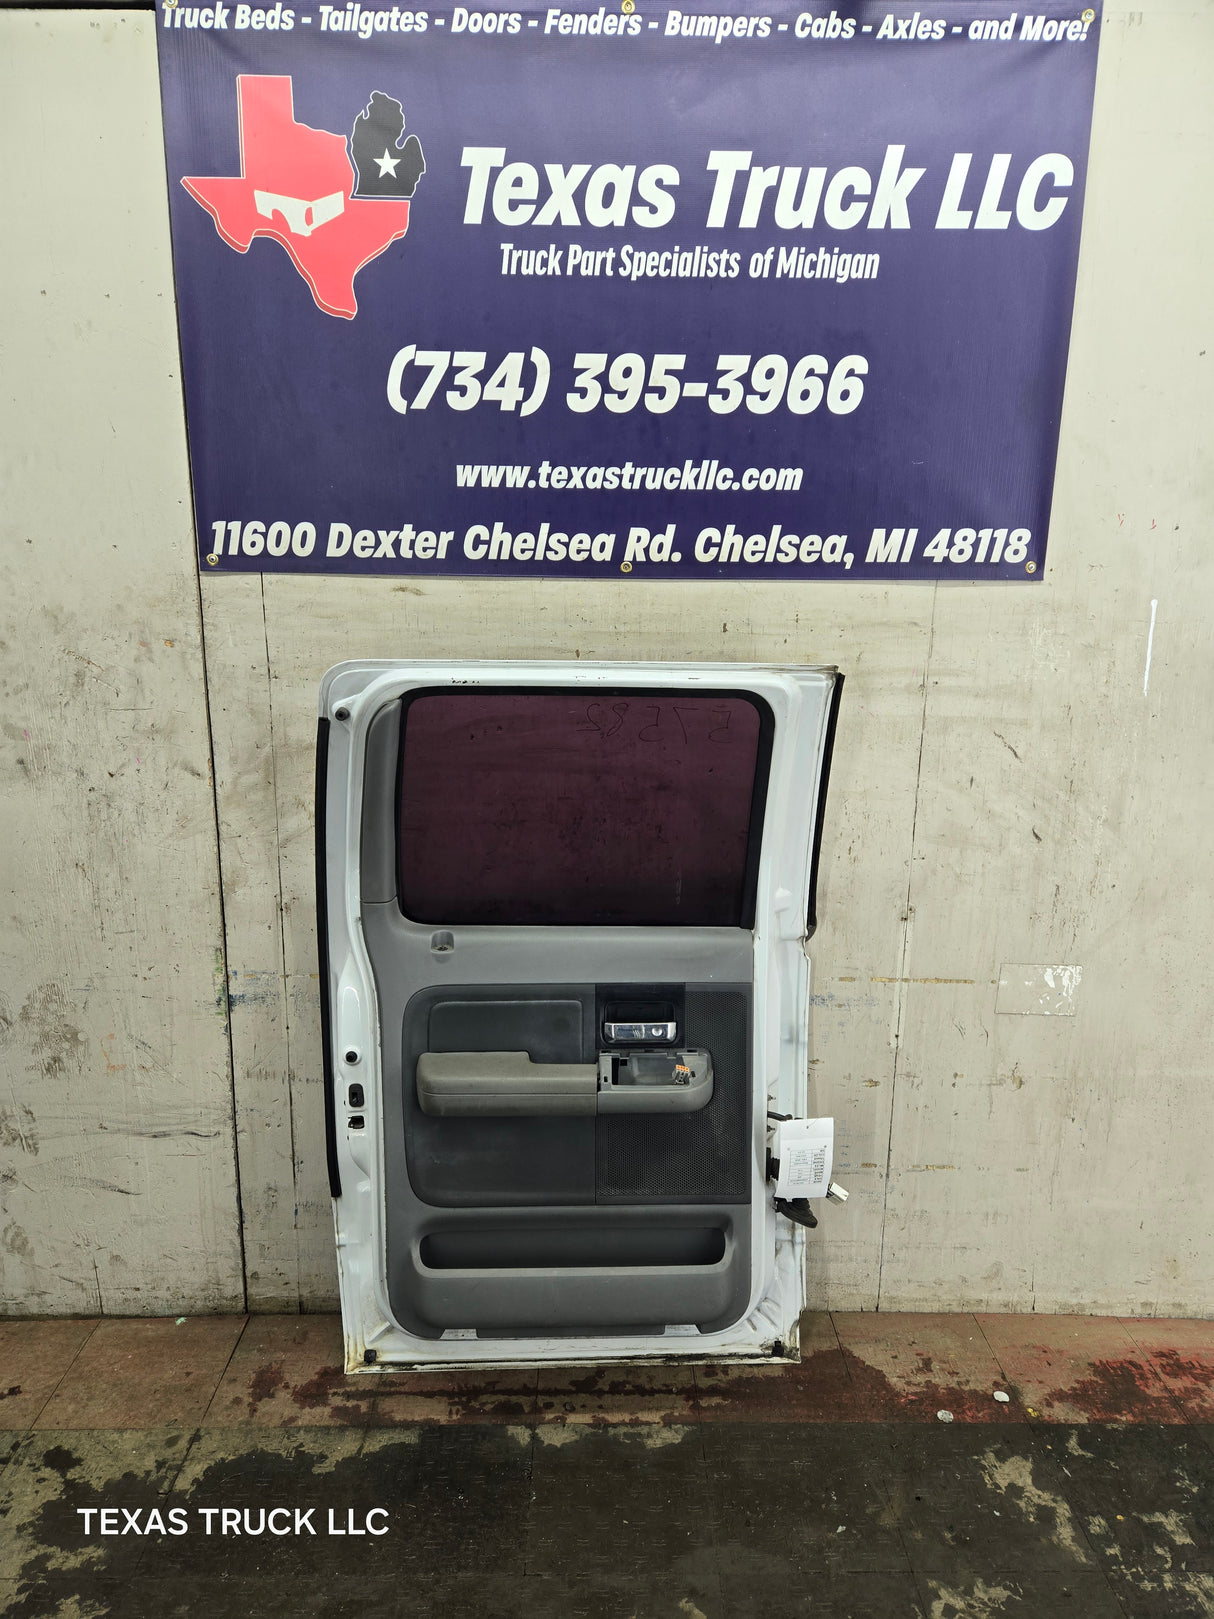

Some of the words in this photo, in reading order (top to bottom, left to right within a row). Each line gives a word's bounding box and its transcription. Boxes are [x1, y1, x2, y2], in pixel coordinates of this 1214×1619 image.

[162, 3, 229, 30] Truck
[235, 3, 296, 30] Beds
[319, 5, 428, 39] Tailgates
[451, 8, 521, 33] Doors
[544, 9, 643, 36] Fenders
[664, 10, 772, 43] Bumpers
[795, 11, 856, 38] Cabs
[876, 12, 946, 39] Axles
[969, 13, 1018, 40] and
[1019, 16, 1089, 41] More!
[461, 147, 679, 228] Texas
[706, 145, 926, 229] Truck
[935, 153, 1074, 230] LLC
[501, 244, 563, 275] Truck
[567, 245, 615, 276] Part
[619, 245, 741, 280] Specialists
[749, 247, 774, 277] of
[776, 247, 879, 283] Michigan
[387, 344, 551, 417] (734)
[567, 353, 868, 414] 395-3966
[457, 460, 803, 490] www.texastruckllc.com
[211, 520, 316, 557] 11600
[327, 523, 454, 558] Dexter
[464, 522, 615, 561] Chelsea
[624, 524, 681, 562] Rd.
[695, 525, 854, 569] Chelsea,
[865, 529, 918, 562] MI
[923, 528, 1031, 563] 48118
